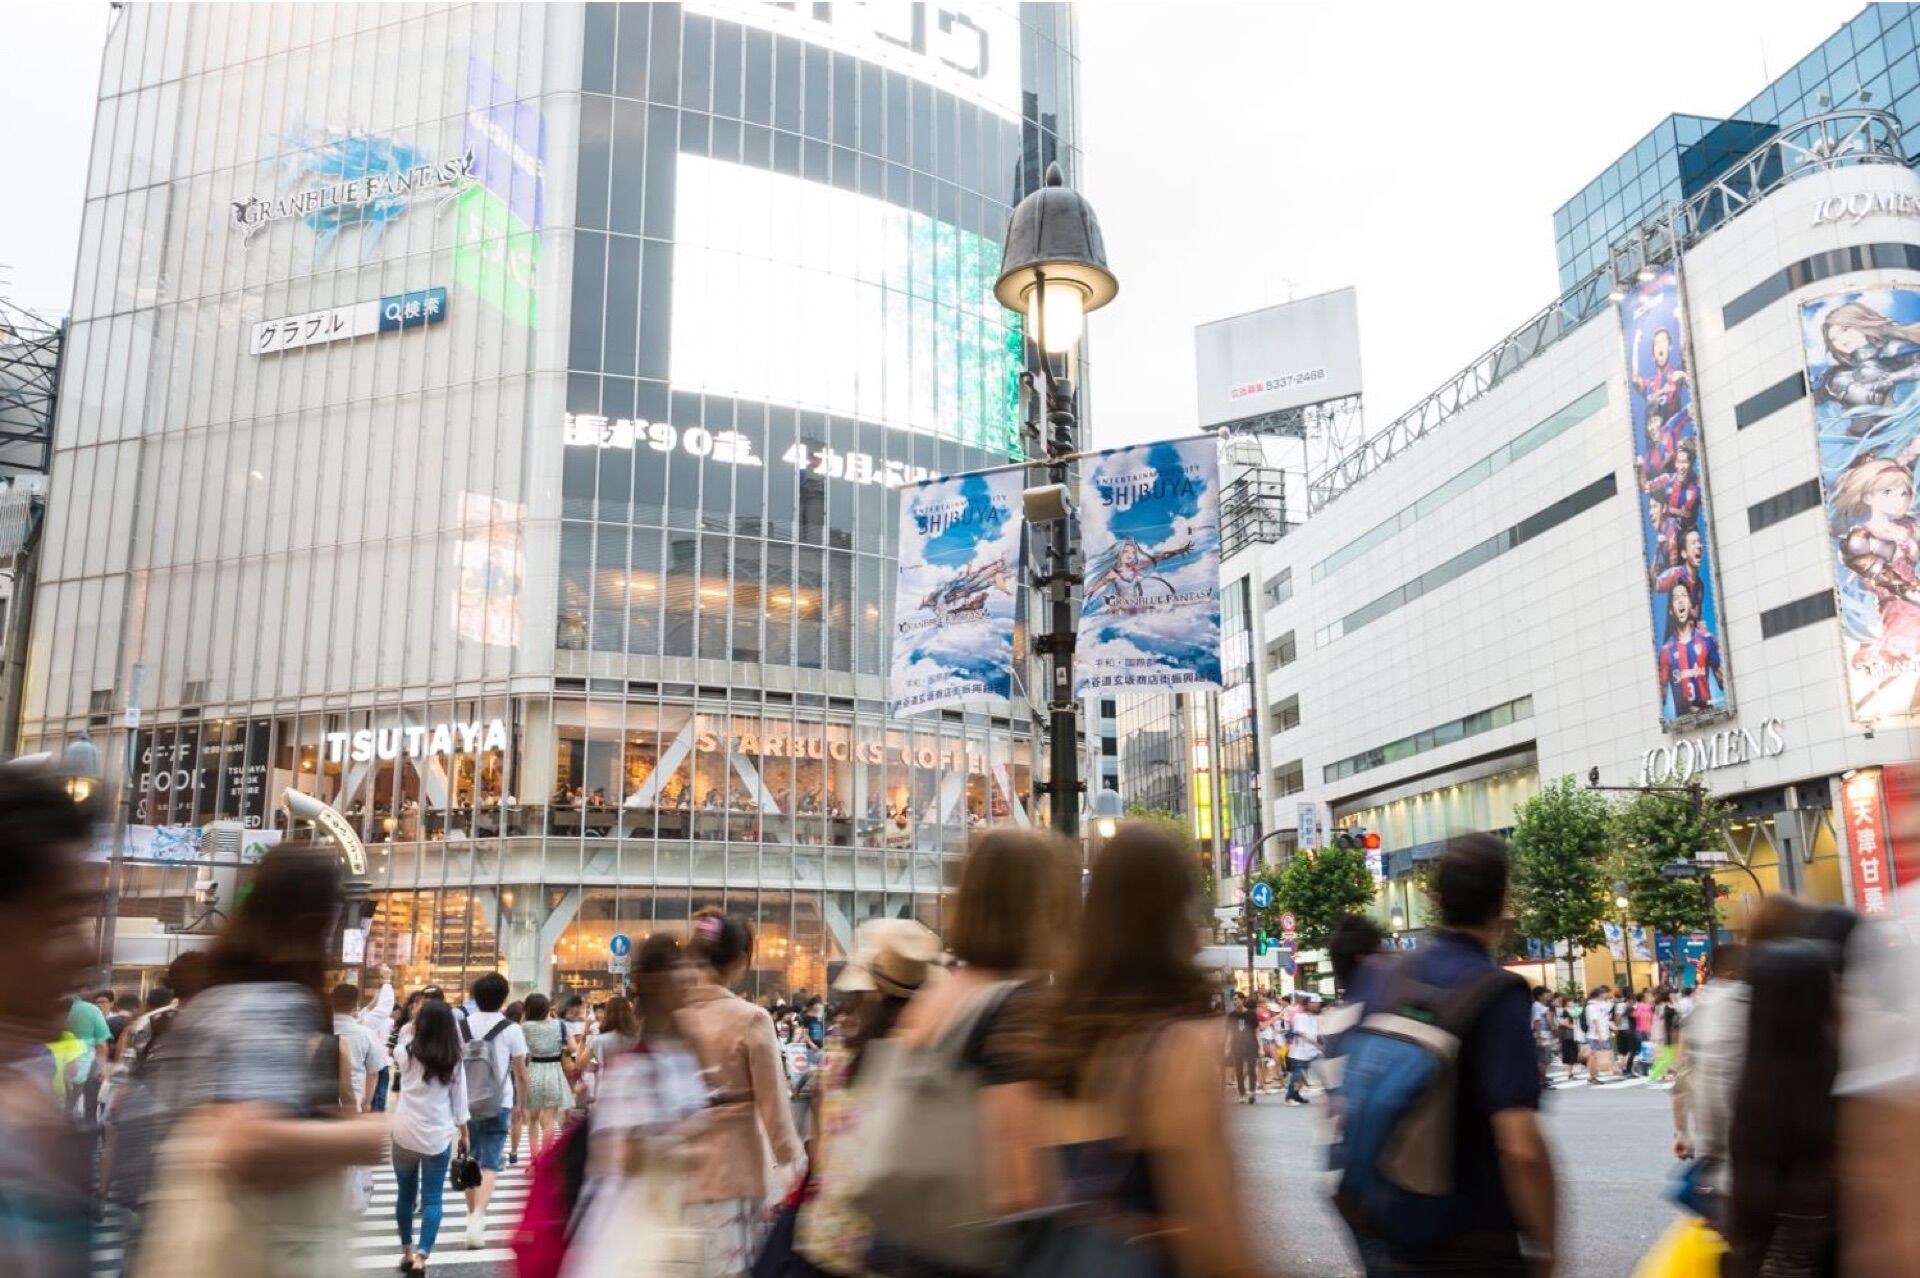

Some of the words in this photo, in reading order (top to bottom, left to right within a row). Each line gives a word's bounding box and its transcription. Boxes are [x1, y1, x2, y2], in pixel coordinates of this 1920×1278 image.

[404, 297, 440, 318] 検索
[1102, 477, 1194, 506] SHIBUYA
[918, 505, 998, 535] SHIBUYA
[327, 718, 507, 763] TSUTAYA
[228, 764, 267, 775] TSUAYA
[231, 786, 260, 796] STRE
